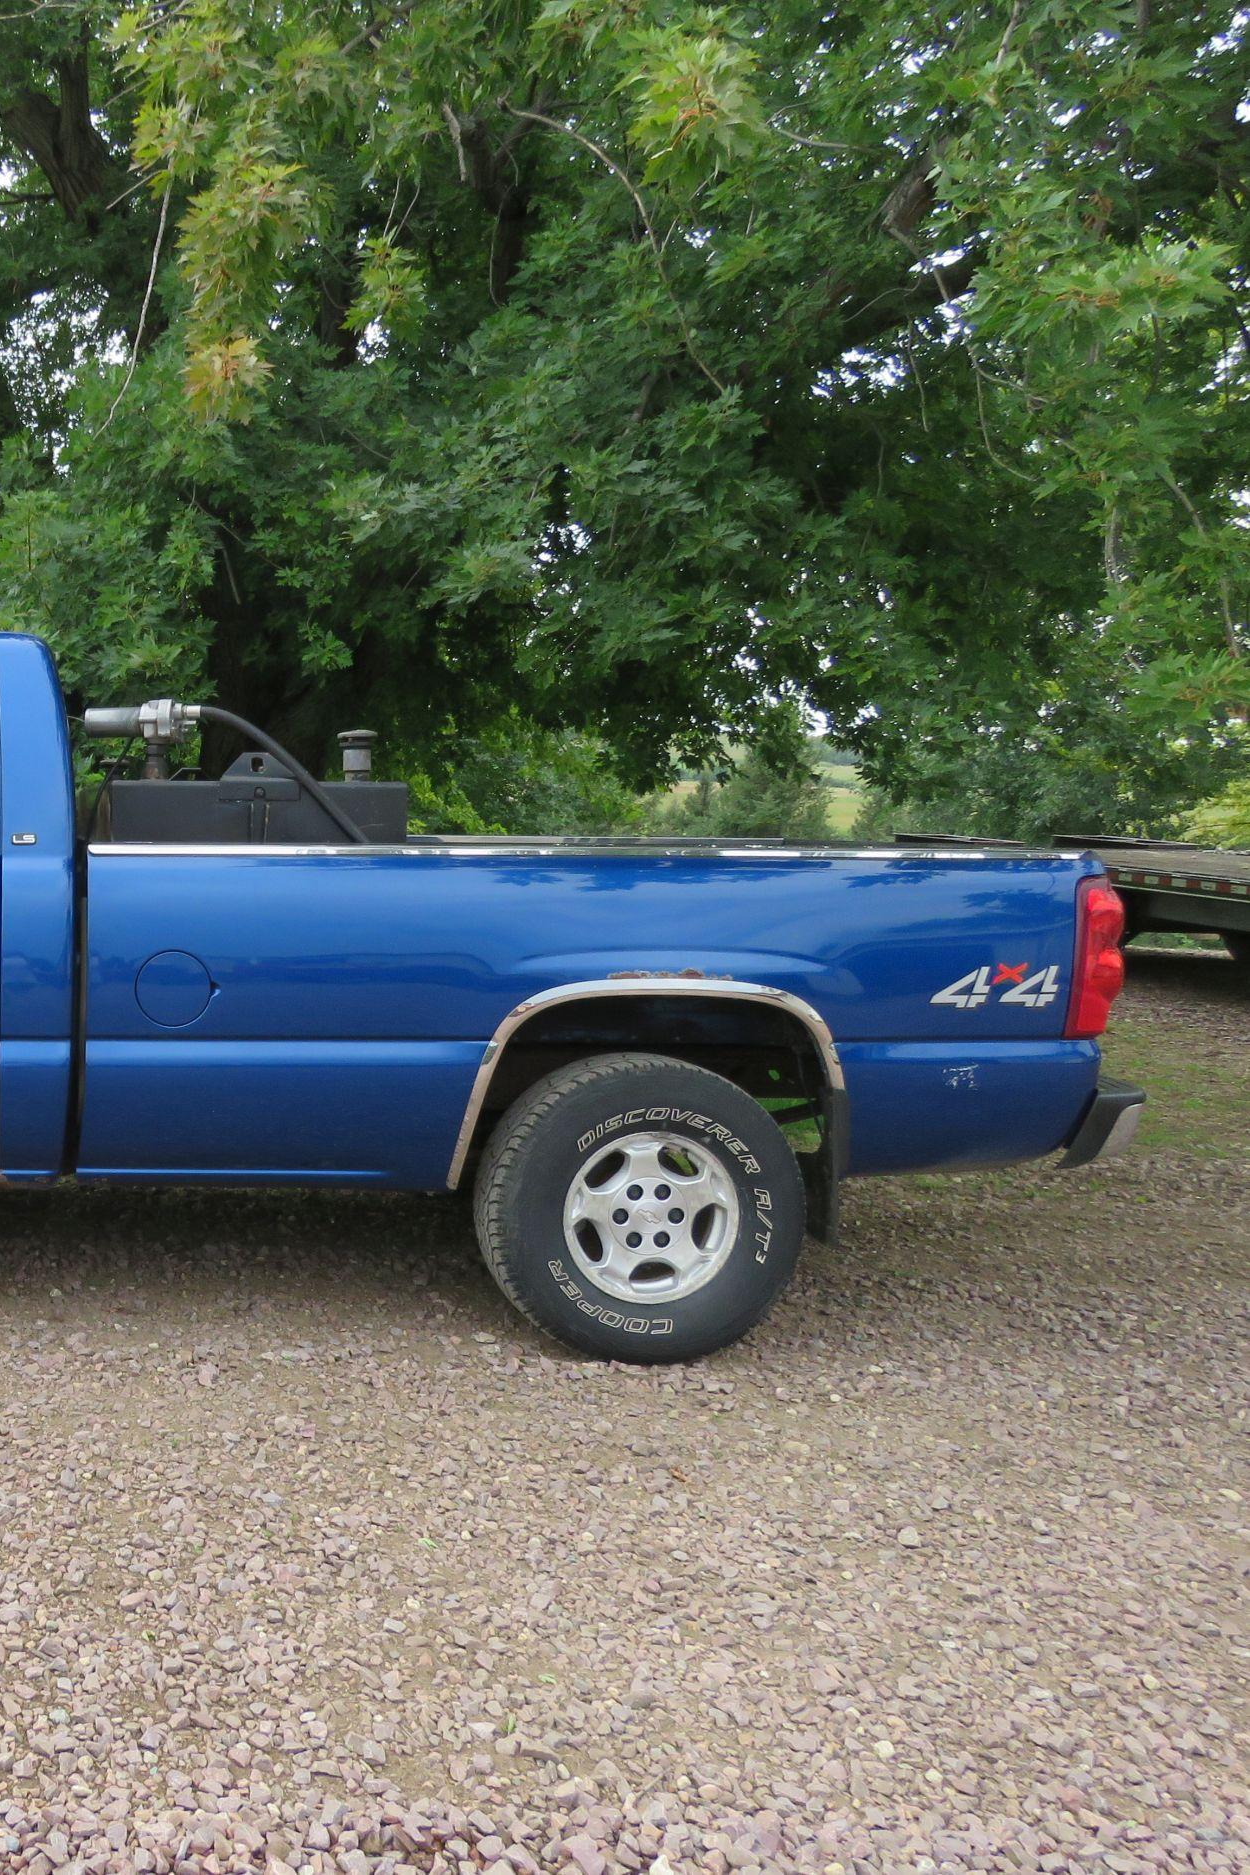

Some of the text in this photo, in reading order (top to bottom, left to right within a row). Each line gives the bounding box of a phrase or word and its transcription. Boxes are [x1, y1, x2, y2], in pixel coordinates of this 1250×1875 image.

[12, 834, 36, 845] LS
[576, 1107, 761, 1175] DISCOVERER
[548, 1259, 674, 1336] COOPER
